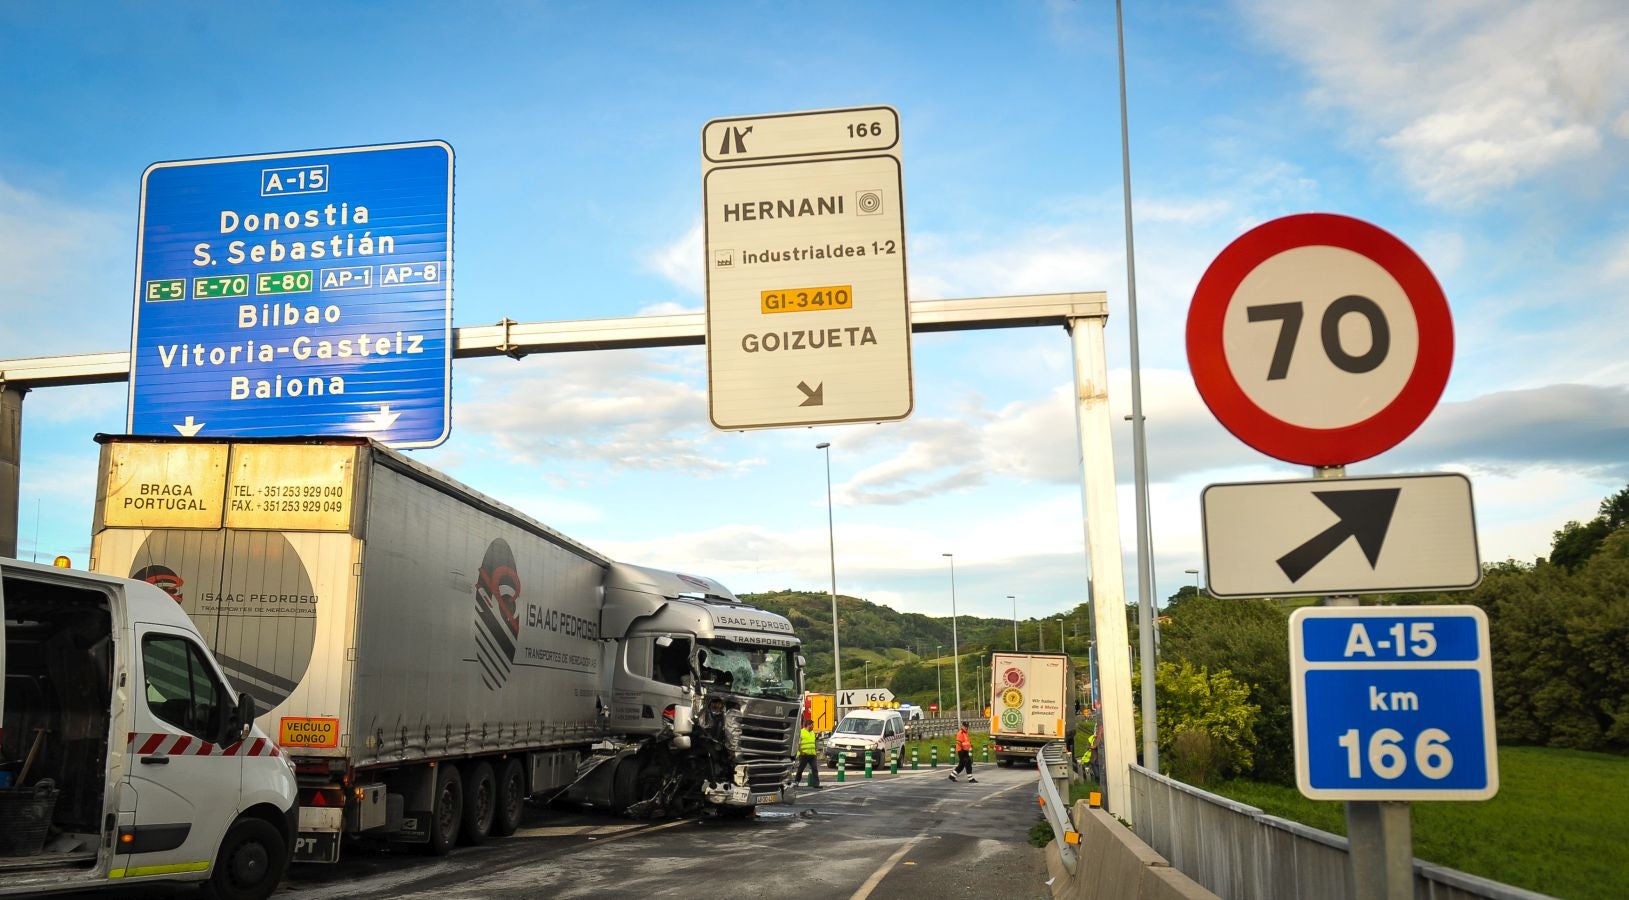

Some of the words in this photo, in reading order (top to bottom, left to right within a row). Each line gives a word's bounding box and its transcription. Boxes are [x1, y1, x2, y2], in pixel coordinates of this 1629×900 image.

[847, 122, 882, 138] 166
[265, 170, 324, 192] A-15
[220, 202, 369, 234] Donostia
[724, 195, 844, 223] HERNANI
[192, 243, 217, 266] S.
[227, 232, 394, 265] Sebastián
[742, 244, 866, 264] industrialdea
[871, 240, 896, 256] 1-2
[148, 282, 182, 299] E-5
[195, 278, 246, 297] E-70
[259, 273, 310, 292] E-80
[324, 270, 370, 288] AP-1
[383, 265, 436, 284] AP-8
[765, 289, 848, 310] GI-3410
[238, 303, 341, 328] Bilbao
[158, 331, 424, 368] Vitoria-Gasteiz
[741, 326, 878, 352] GOIZUETA
[1246, 294, 1390, 381] 70
[230, 375, 345, 400] Baiona
[140, 483, 193, 496] BRAGA
[233, 485, 254, 497] TEL.
[303, 486, 321, 497] 929
[324, 486, 343, 498] 040
[124, 497, 207, 511] PORTUGAL
[231, 499, 254, 511] FAX.
[303, 501, 321, 512] 929
[323, 501, 342, 512] 049
[201, 593, 244, 603] ISAAC
[250, 594, 318, 604] PEDROSO
[526, 603, 558, 632] ISAAC
[560, 612, 598, 642] PEDROSO
[716, 615, 747, 626] ISAAC
[749, 619, 790, 631] PEDROSO
[733, 635, 791, 647] TRANSPORTES
[1344, 622, 1437, 658] A-15
[866, 692, 886, 702] 166
[1369, 685, 1419, 711] km
[290, 734, 326, 743] LONGO
[1338, 727, 1454, 780] 166
[294, 837, 317, 854] PT
